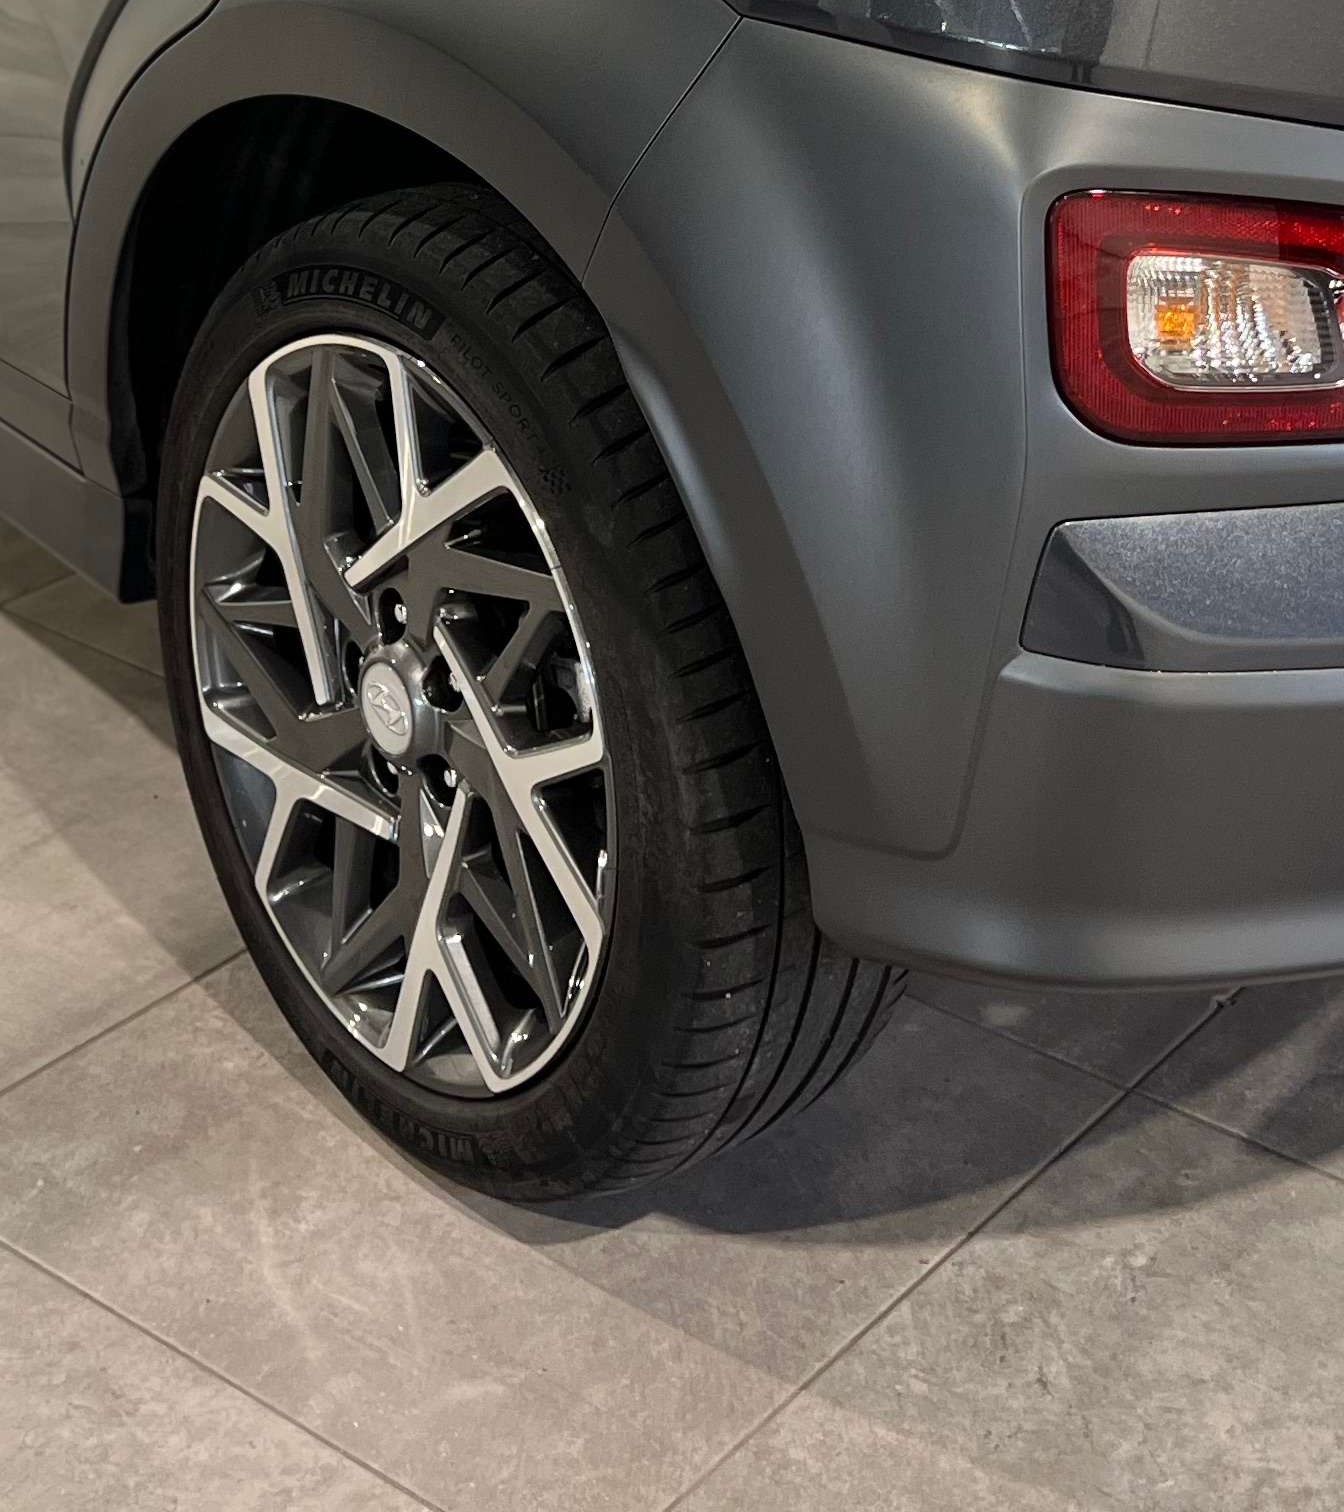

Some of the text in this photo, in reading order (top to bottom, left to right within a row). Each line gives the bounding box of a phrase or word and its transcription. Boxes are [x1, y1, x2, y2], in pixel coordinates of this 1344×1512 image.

[287, 268, 433, 329] MICHELIN
[450, 334, 493, 377] PILOT
[492, 381, 538, 440] SPORT
